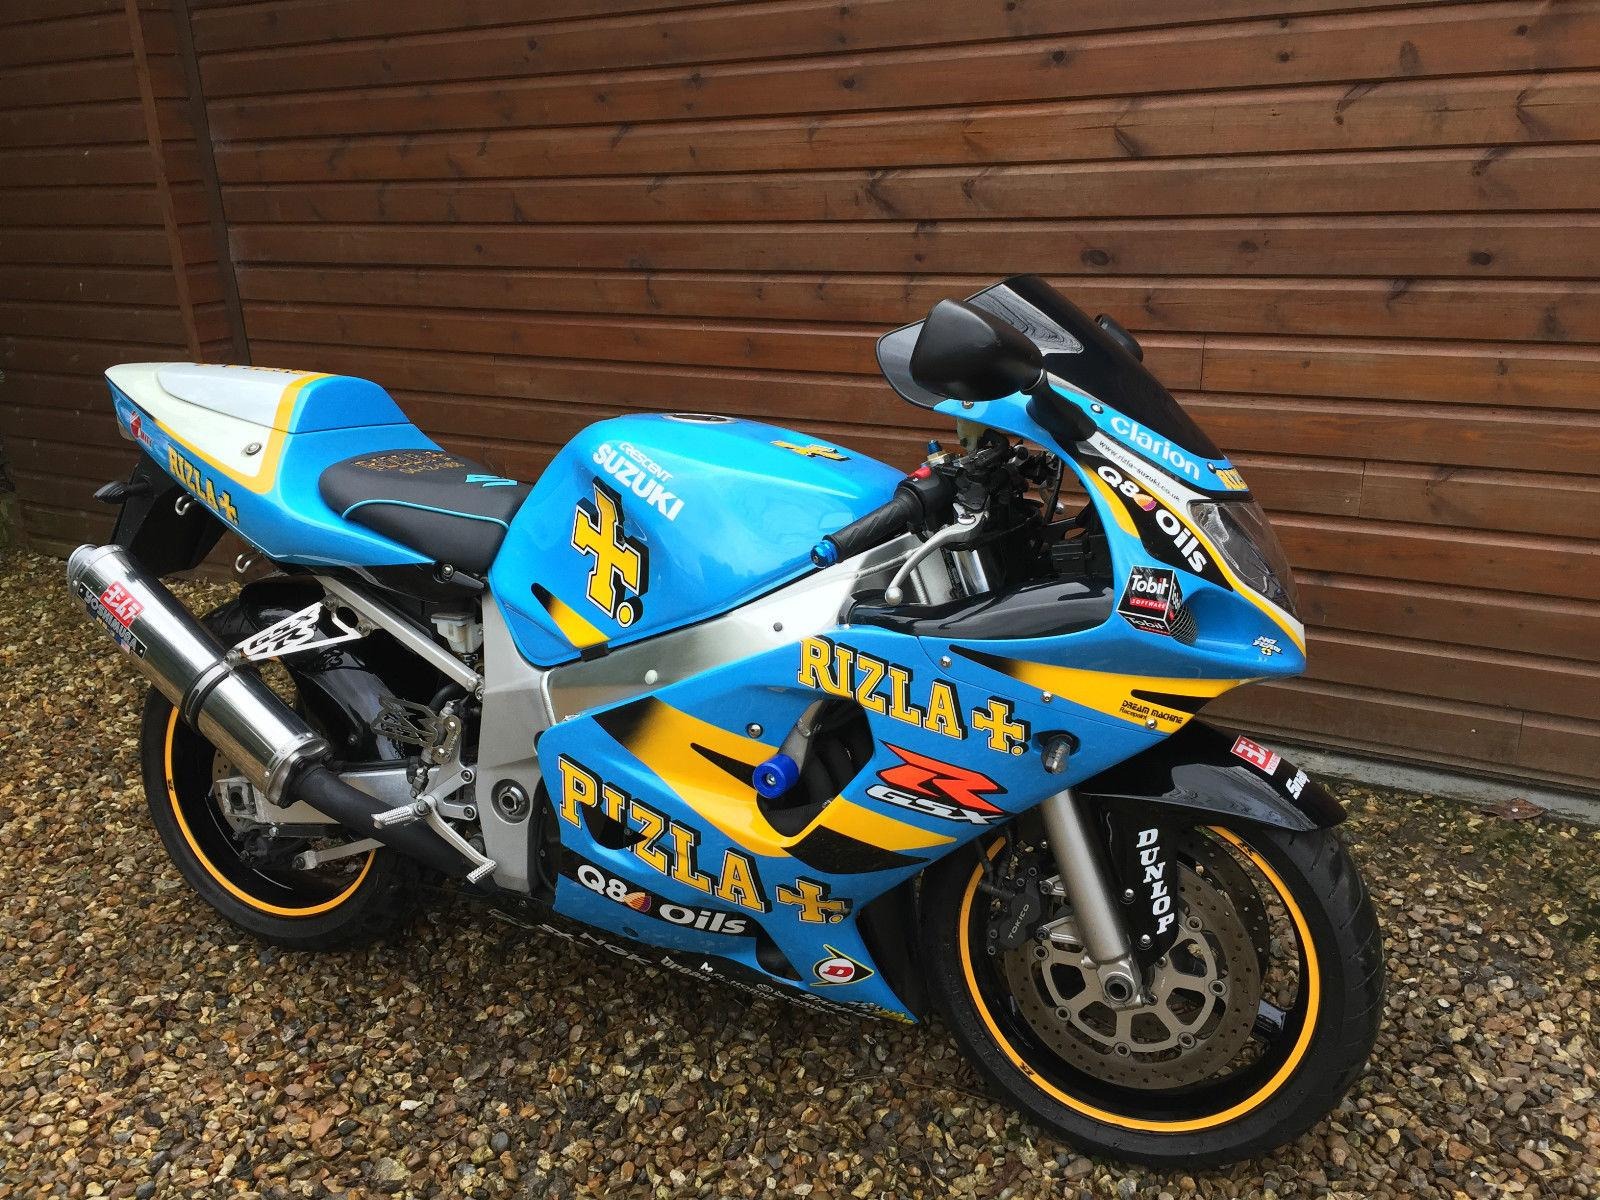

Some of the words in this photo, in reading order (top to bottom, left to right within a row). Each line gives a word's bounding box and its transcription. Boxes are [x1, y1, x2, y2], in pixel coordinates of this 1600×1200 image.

[592, 443, 685, 521] SUZUKI
[618, 442, 673, 483] CRESCENT
[1097, 465, 1140, 498] Q8
[1155, 509, 1207, 573] Oils
[1131, 574, 1169, 595] Tobit
[1131, 598, 1168, 610] SOFTWARE
[798, 635, 968, 740] RIZLA
[1121, 699, 1150, 715] DREAM
[1150, 709, 1184, 725] MACHINE
[865, 784, 1011, 825] GSX
[577, 864, 629, 902] Q8
[658, 903, 747, 934] Oils
[1136, 828, 1175, 935] DUNLOP
[1007, 903, 1030, 940] TOKICO
